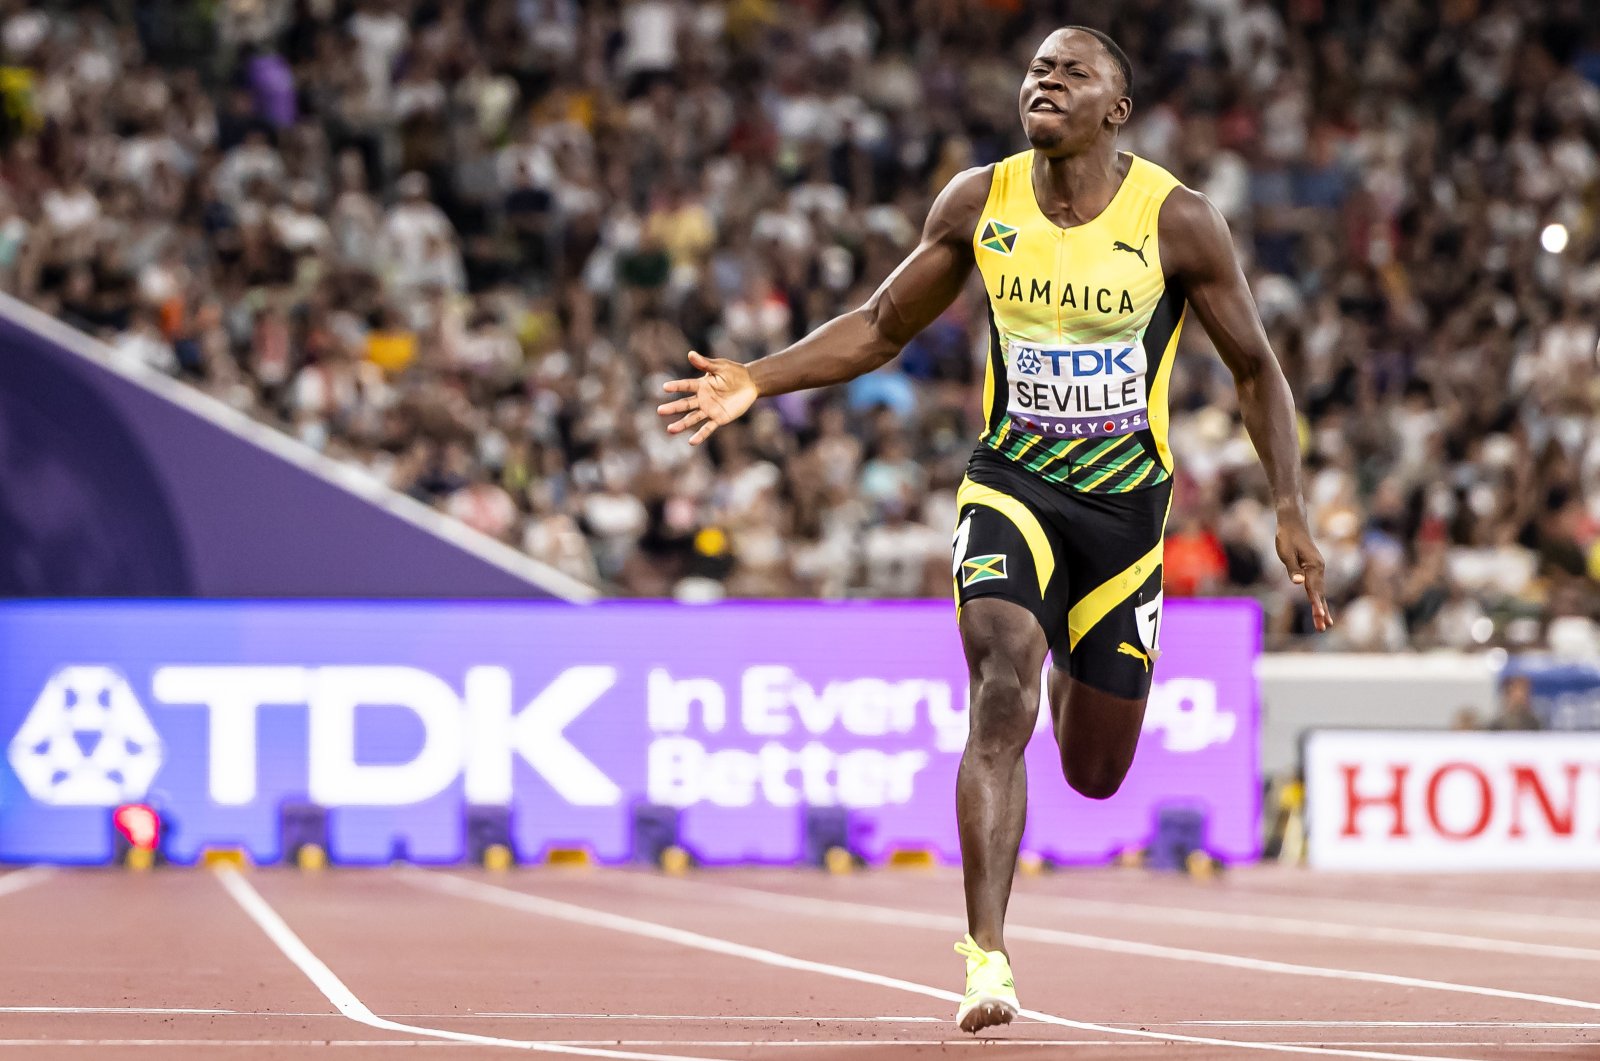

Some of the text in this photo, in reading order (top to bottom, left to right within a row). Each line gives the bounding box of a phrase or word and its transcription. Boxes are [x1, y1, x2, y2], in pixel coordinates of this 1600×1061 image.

[995, 274, 1134, 314] JAMAICA
[1016, 378, 1138, 412] SEVILLE
[1041, 347, 1136, 377] TDK
[648, 667, 726, 734] In
[152, 664, 622, 807] TDK
[648, 735, 929, 808] Better
[1338, 761, 1600, 842] HON
